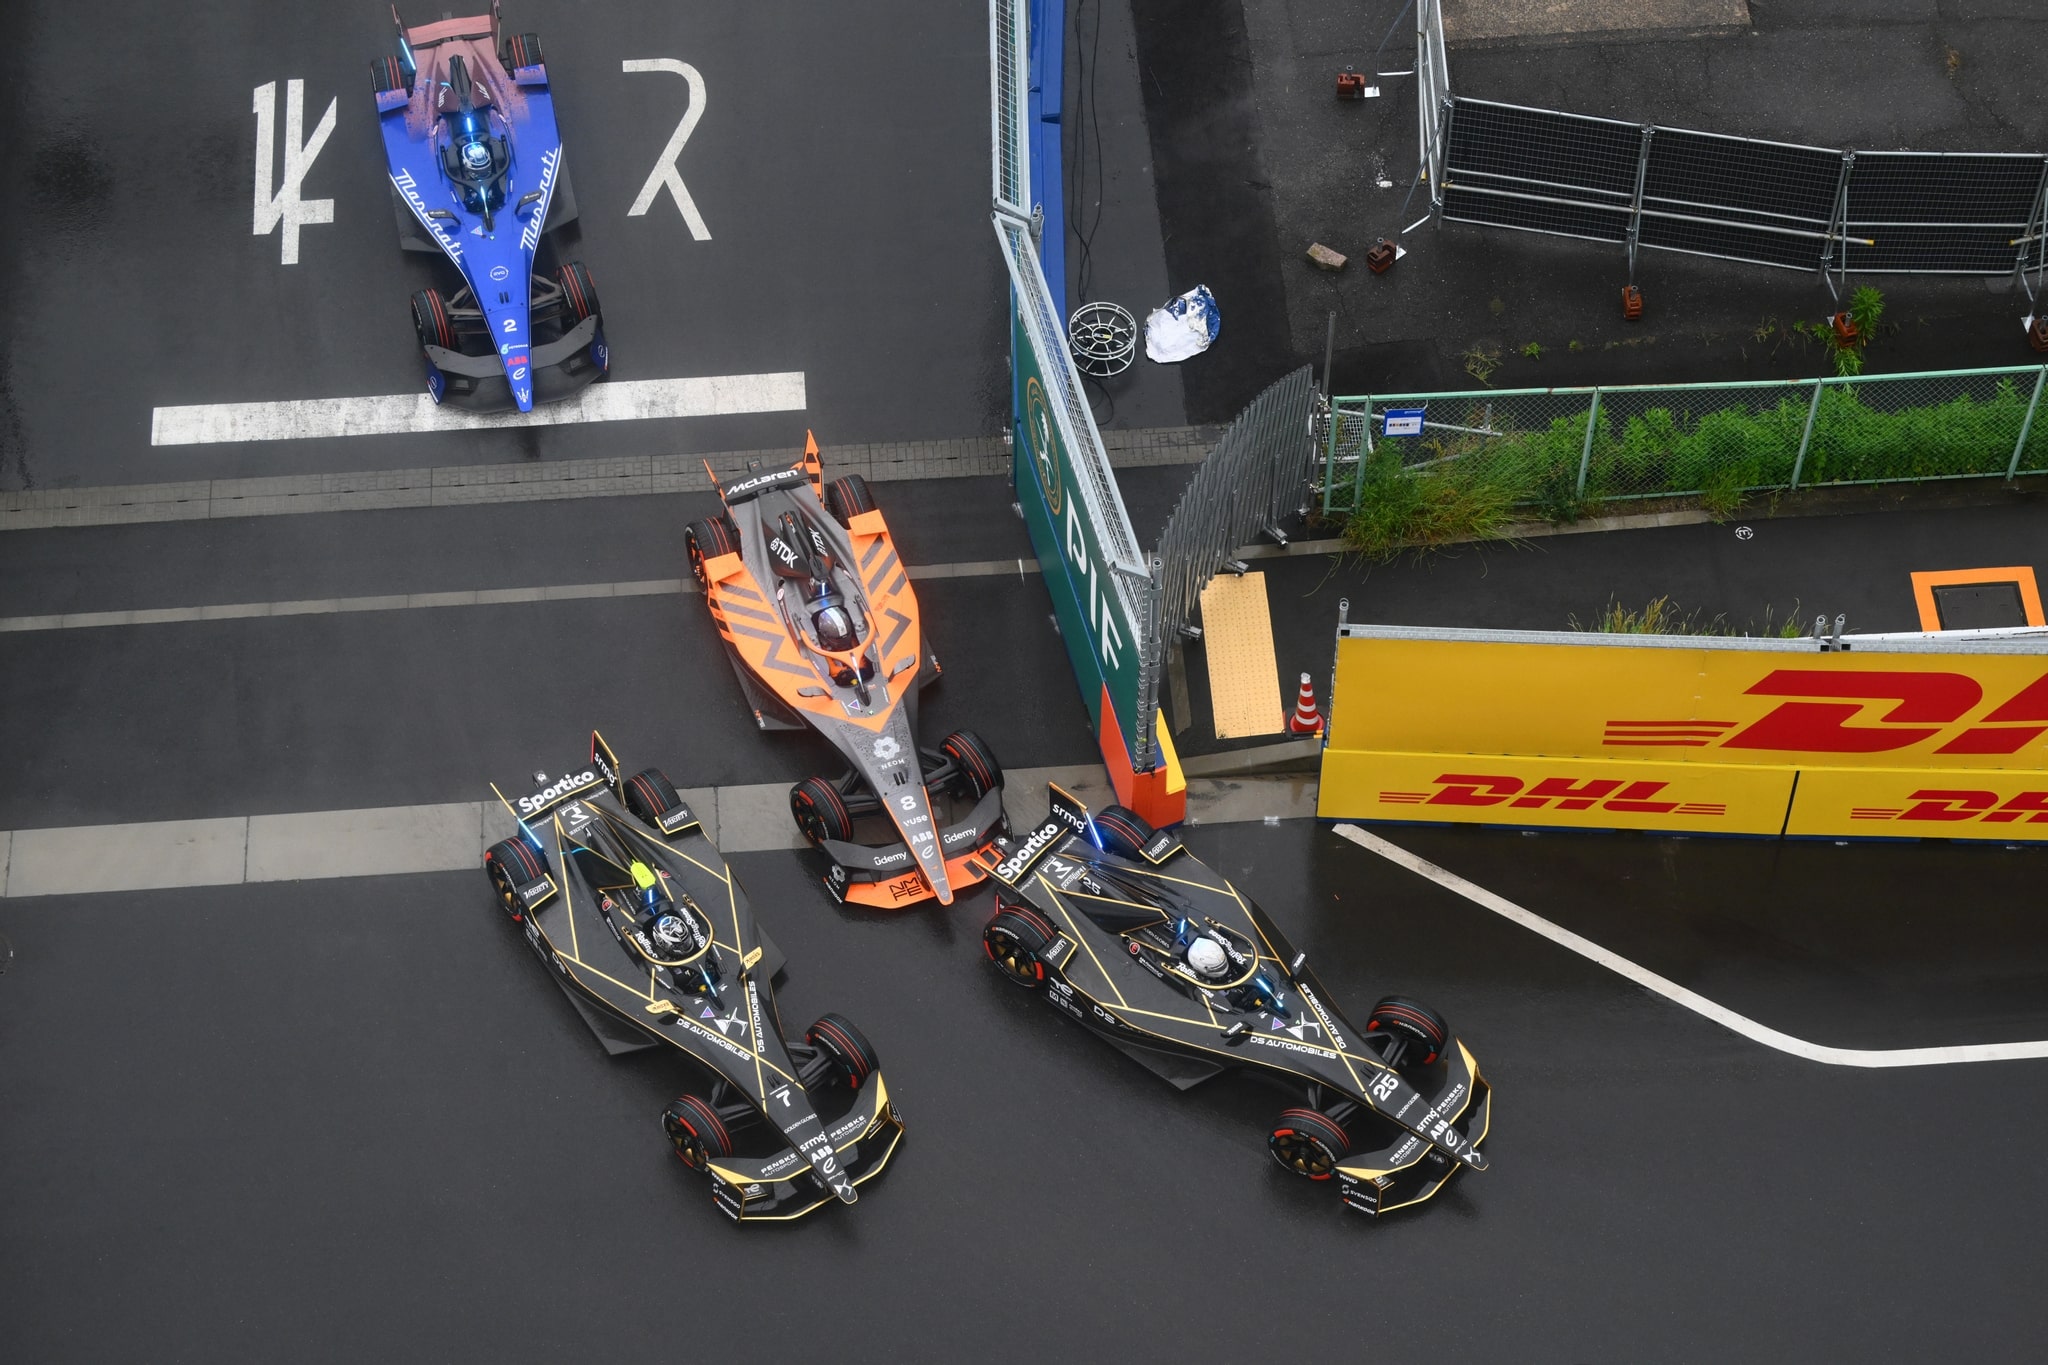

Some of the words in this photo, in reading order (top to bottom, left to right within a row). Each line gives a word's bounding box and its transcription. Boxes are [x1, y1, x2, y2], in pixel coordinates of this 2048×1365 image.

[503, 319, 518, 333] 2
[507, 356, 529, 367] ABB
[726, 468, 799, 496] McLaren
[776, 540, 799, 569] TDK
[1066, 487, 1123, 671] PIF
[881, 758, 905, 770] NEOM
[518, 771, 595, 813] Sportico
[900, 795, 917, 811] 8
[1425, 773, 1681, 814] DHL
[1052, 803, 1087, 834] srmg
[912, 831, 934, 845] ABB
[997, 823, 1059, 879] Sportico
[1083, 876, 1101, 896] 25
[748, 980, 764, 1039] AUTOMOBILES
[1093, 1004, 1115, 1025] DS
[1300, 982, 1339, 1038] AUTOMOBILES
[676, 1018, 692, 1029] DS
[689, 1024, 752, 1062] AUTOMOBILES
[1250, 1036, 1265, 1045] DS
[1265, 1039, 1337, 1060] AUTOMOBILES
[775, 1089, 792, 1108] 7
[1373, 1074, 1399, 1102] 25
[1436, 1083, 1464, 1113] PENSKE
[830, 1115, 866, 1139] PENSKE
[833, 1119, 868, 1143] AUTOSPORT
[1416, 1107, 1440, 1133] srmg
[1429, 1120, 1450, 1141] ABB
[800, 1130, 829, 1153] srmg
[1389, 1135, 1418, 1164] PENSKE
[760, 1152, 797, 1175] PENSKE
[811, 1145, 834, 1164] ABB
[764, 1157, 801, 1177] AUTOSPORT
